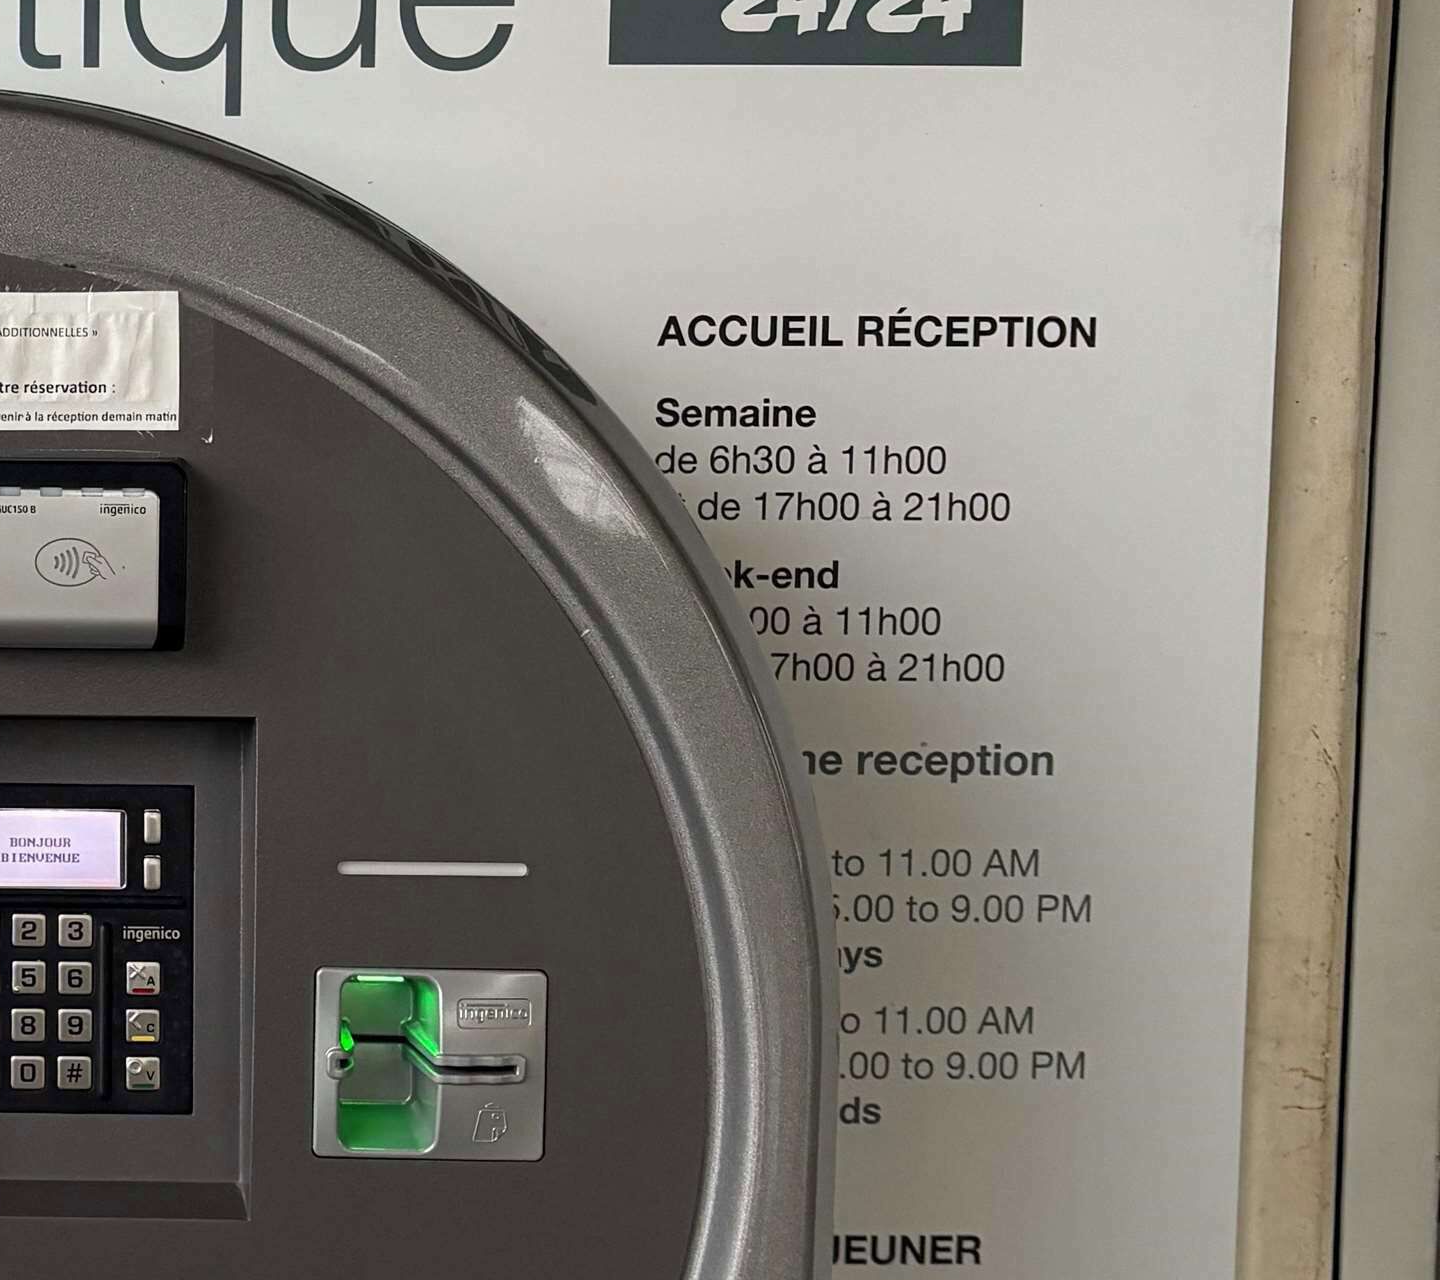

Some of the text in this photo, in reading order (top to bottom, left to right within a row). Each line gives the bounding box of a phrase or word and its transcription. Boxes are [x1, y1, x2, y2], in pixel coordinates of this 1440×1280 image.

[657, 307, 1096, 348] ACCUEIL RÉCEPTION
[23, 380, 107, 394] réservation
[34, 411, 44, 422] la
[46, 410, 99, 424] réception
[101, 411, 143, 422] demain
[145, 411, 177, 422] matin
[656, 398, 816, 427] Semaine
[655, 445, 946, 474] de 6h30 à 11h00
[99, 503, 147, 517] ingenico
[698, 492, 740, 520] de
[755, 492, 859, 520] 17h00
[873, 491, 891, 521] à
[904, 492, 1010, 521] 21h00
[803, 606, 940, 635] à 11h00
[868, 652, 1004, 682] à 21h00
[858, 743, 1053, 783] reception
[9, 837, 71, 848] BONJOUR
[1, 852, 80, 863] BIENVENUE
[832, 849, 1038, 877] to 11.00 AM
[906, 895, 1090, 923] to 9.00 PM
[21, 920, 37, 940] 2
[68, 921, 83, 941] 3
[122, 925, 181, 942] ingenico
[21, 968, 36, 987] 5
[67, 969, 83, 988] 6
[21, 1015, 36, 1035] 8
[67, 1016, 83, 1036] 9
[875, 1006, 1033, 1034] 11.00 AM
[20, 1063, 36, 1083] 0
[901, 1051, 1085, 1080] to 9.00 PM
